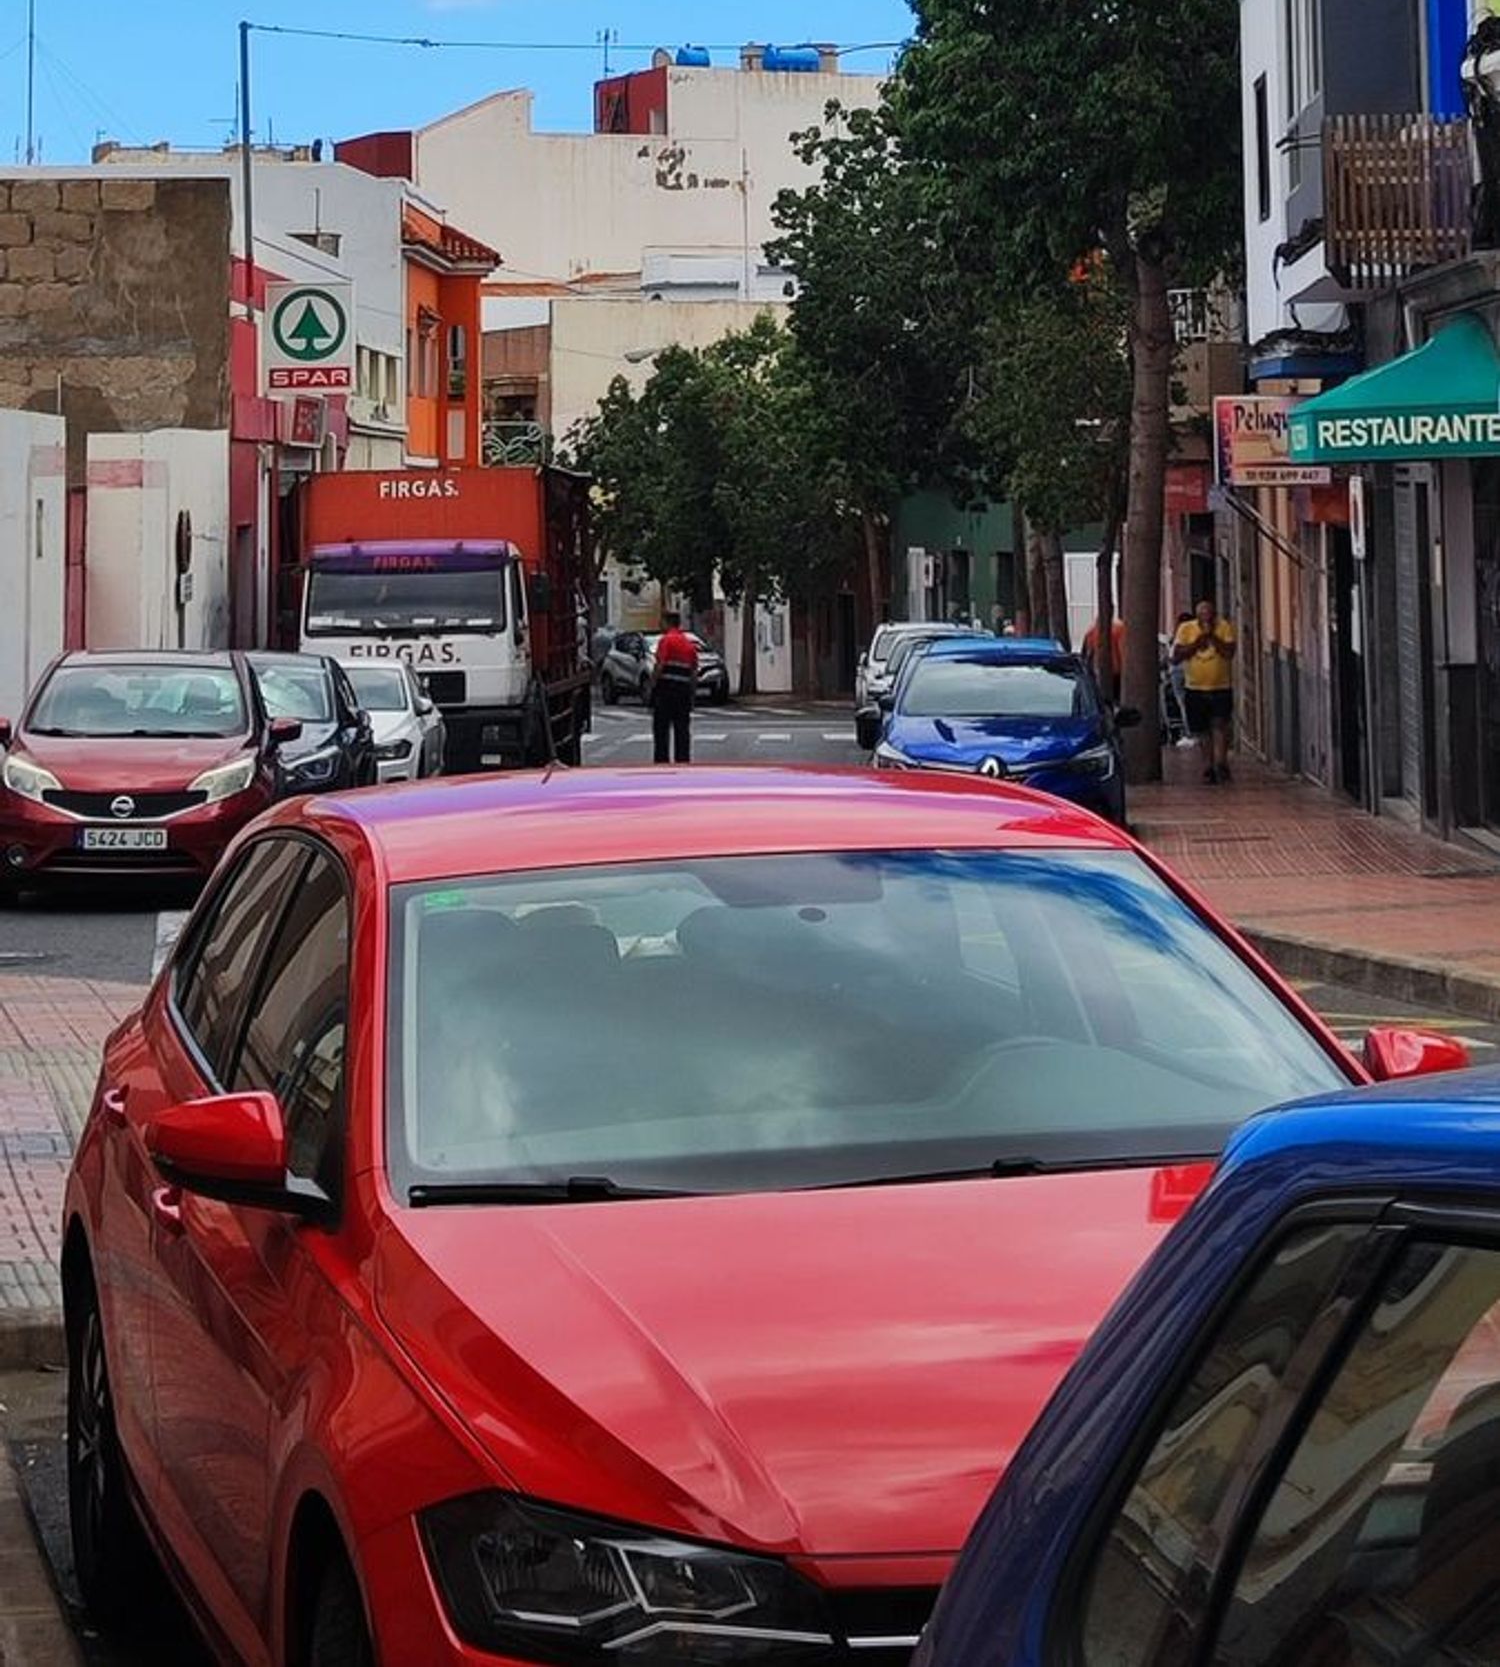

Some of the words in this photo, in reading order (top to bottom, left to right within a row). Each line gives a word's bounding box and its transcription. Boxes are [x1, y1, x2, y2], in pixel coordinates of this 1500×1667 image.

[271, 370, 348, 386] SPAR
[1317, 414, 1500, 449] RESTAURANTE
[380, 479, 459, 498] FIRGAS.
[87, 831, 127, 846] 5424
